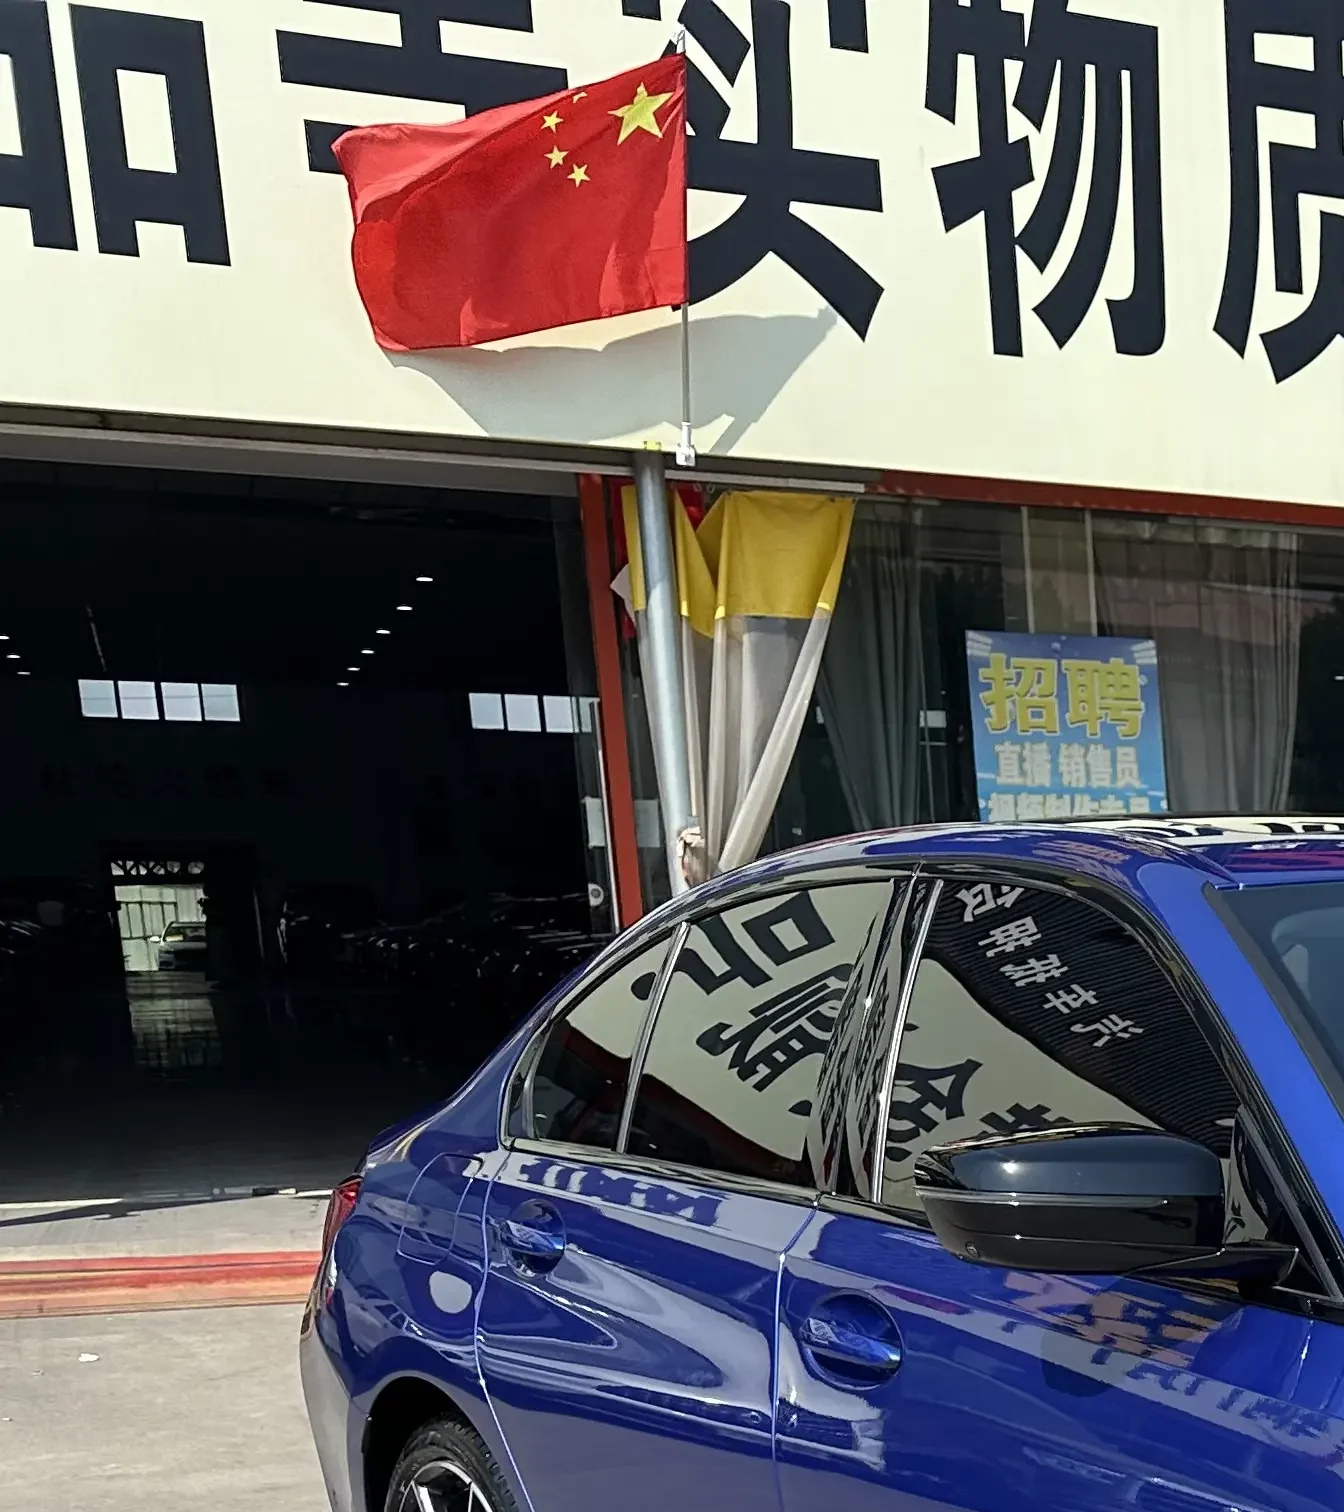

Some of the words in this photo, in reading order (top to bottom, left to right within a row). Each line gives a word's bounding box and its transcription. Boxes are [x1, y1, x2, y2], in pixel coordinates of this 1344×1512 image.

[979, 652, 1143, 739] 招聘
[994, 742, 1052, 787] 直播
[1058, 743, 1142, 788] 销售员
